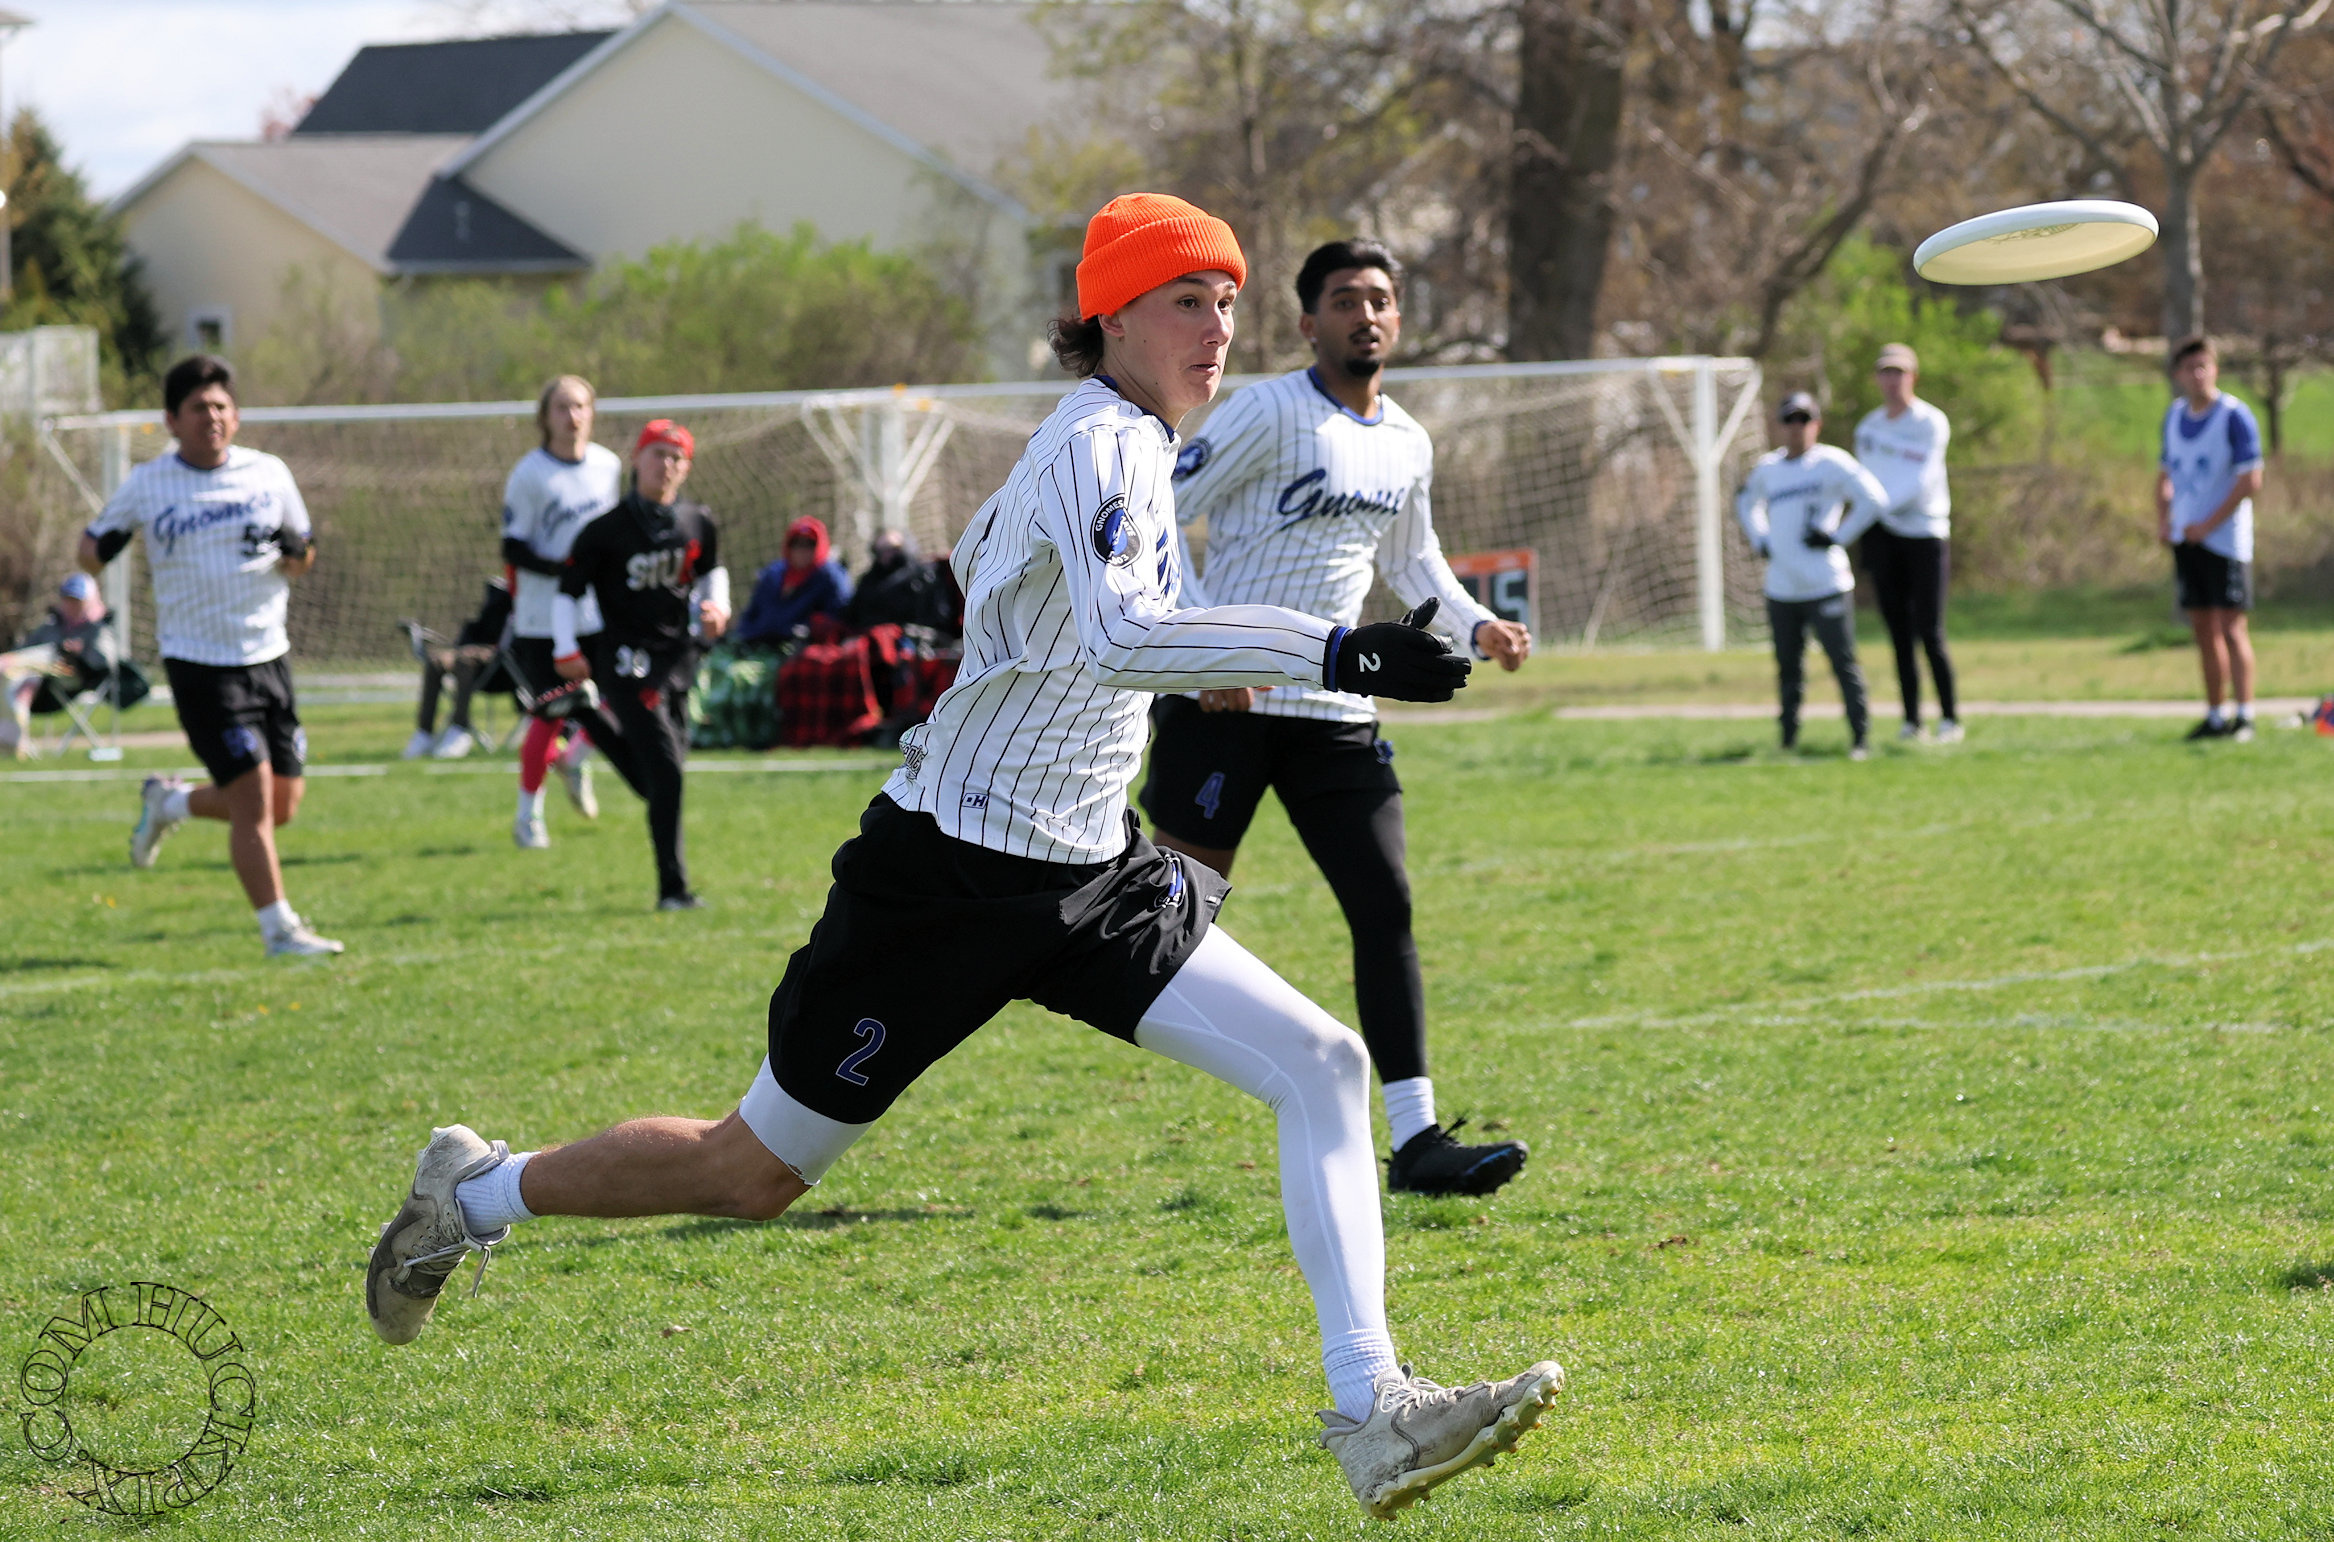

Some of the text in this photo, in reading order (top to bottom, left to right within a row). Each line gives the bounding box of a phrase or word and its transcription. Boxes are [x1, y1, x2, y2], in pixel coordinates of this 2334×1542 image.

[1095, 499, 1125, 533] GNOMES
[1358, 652, 1382, 673] 2
[1195, 771, 1226, 820] 4
[835, 1017, 887, 1087] 2
